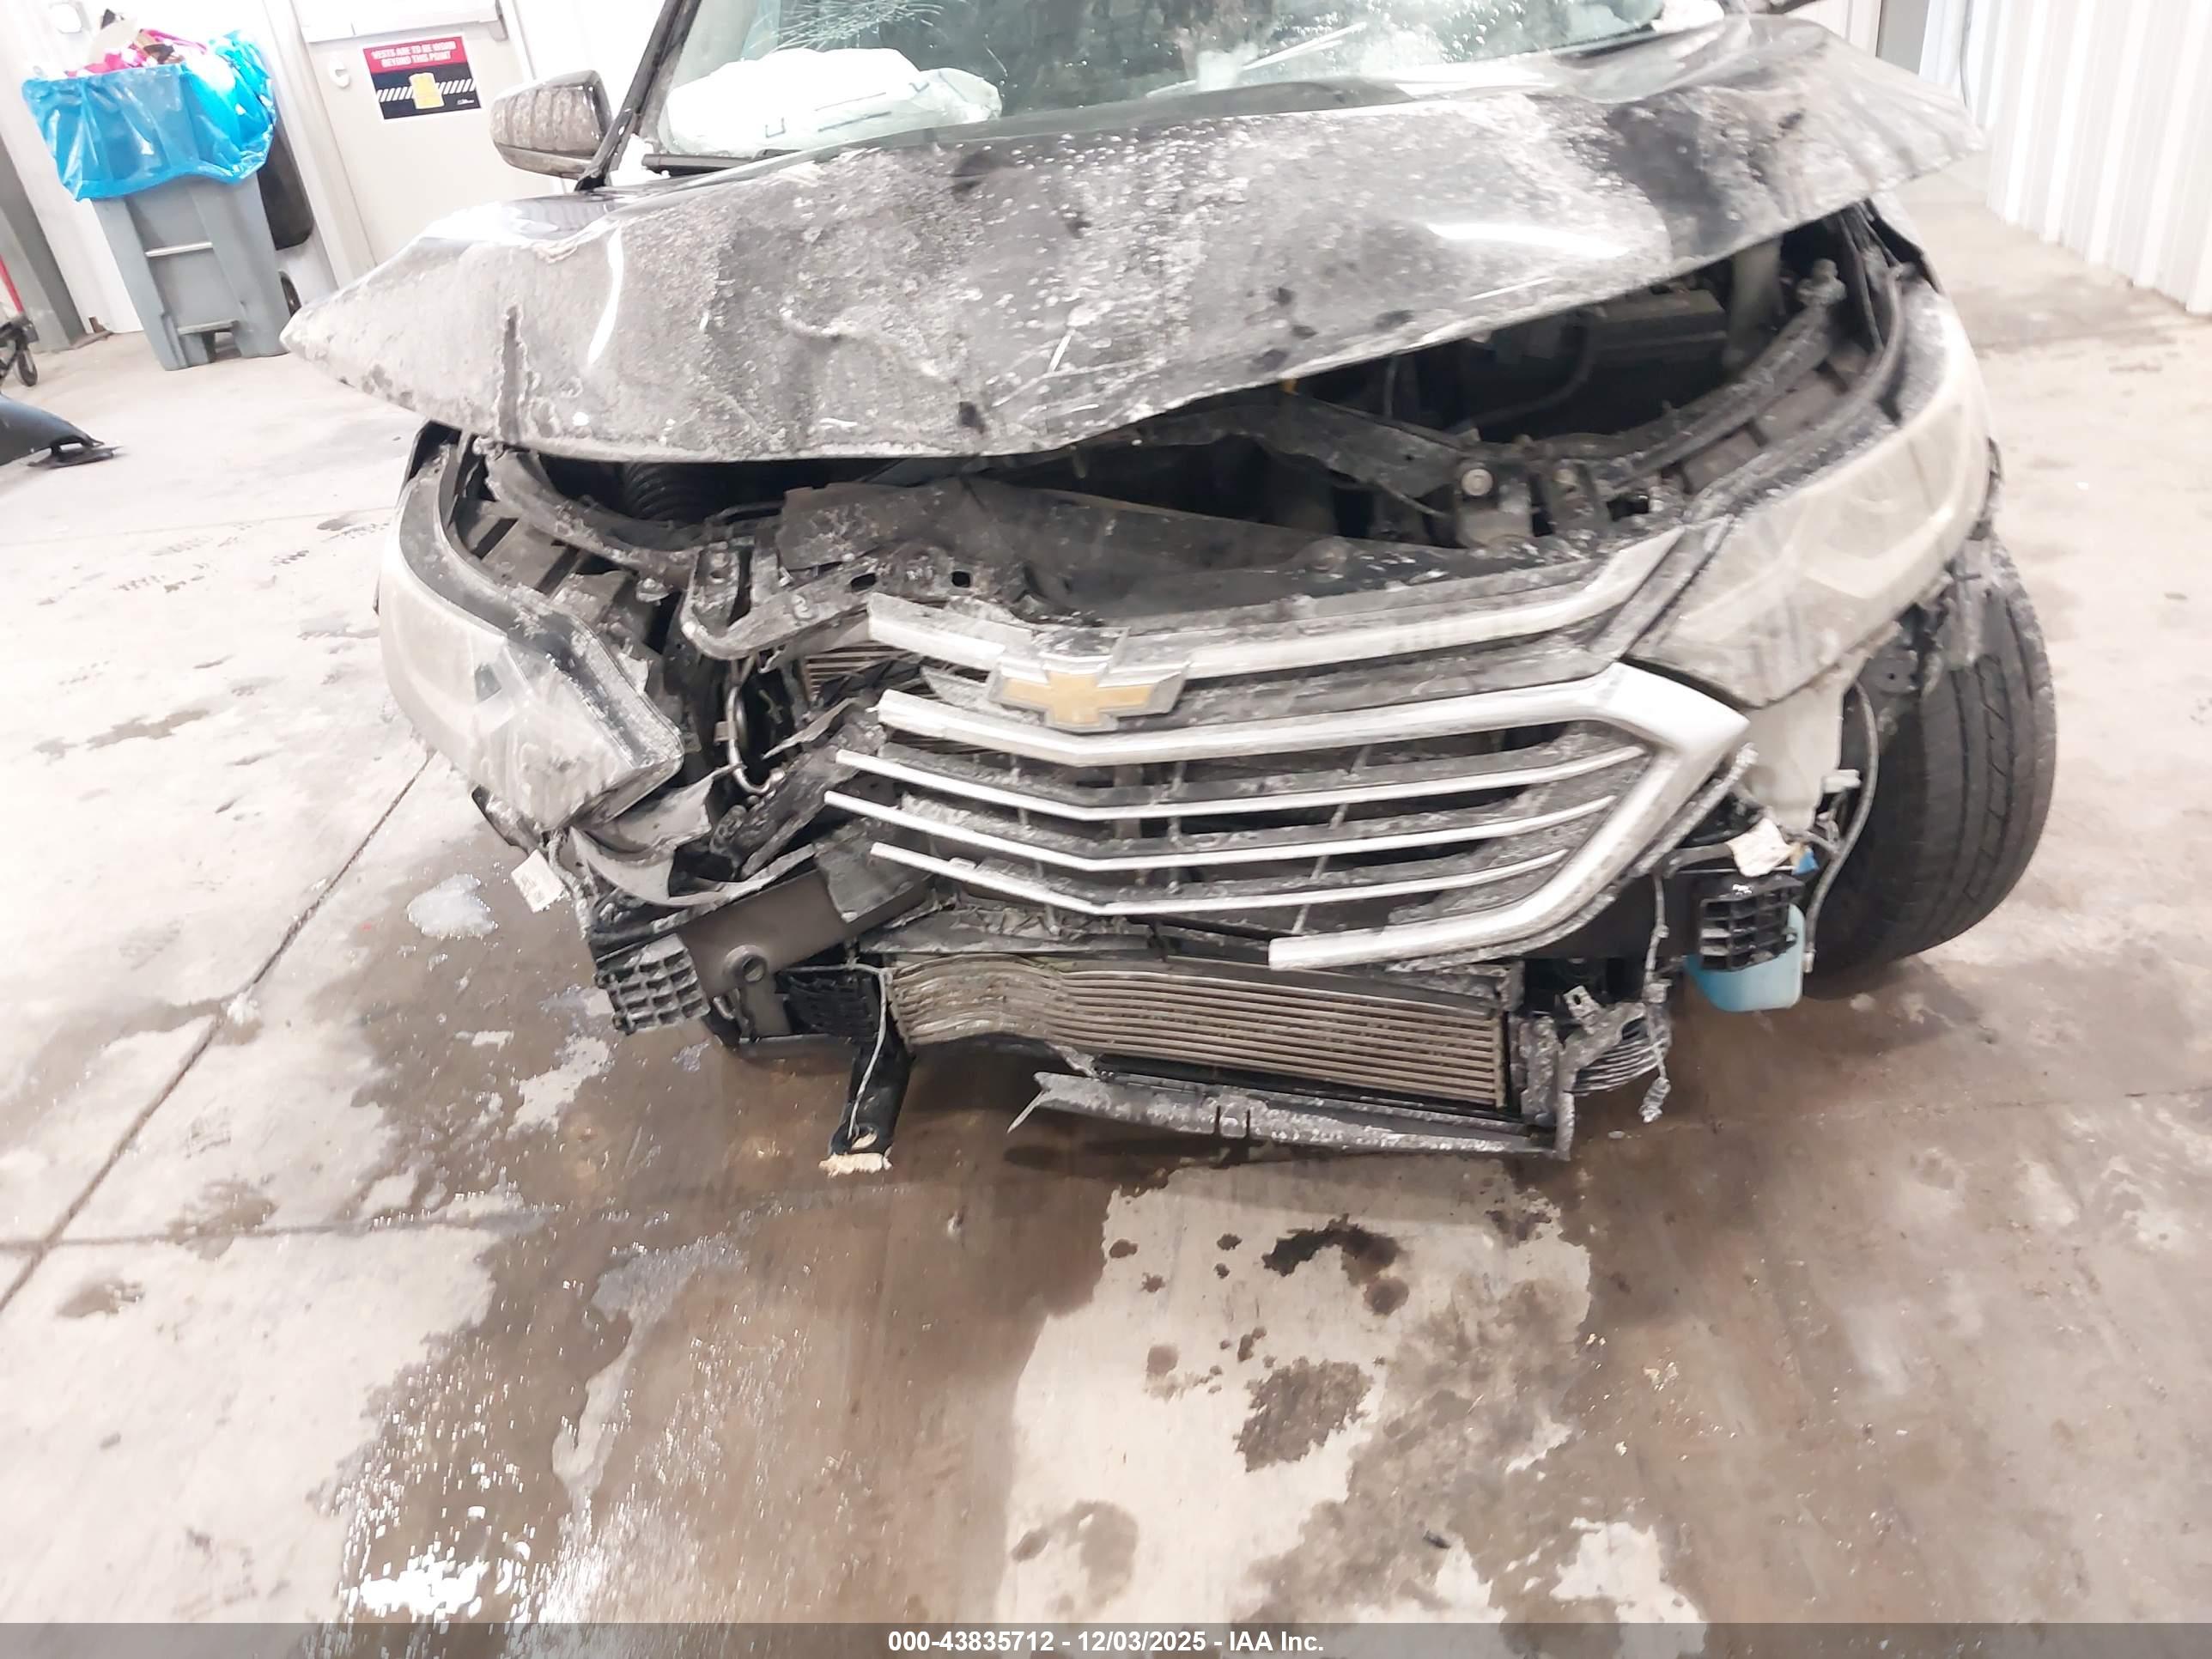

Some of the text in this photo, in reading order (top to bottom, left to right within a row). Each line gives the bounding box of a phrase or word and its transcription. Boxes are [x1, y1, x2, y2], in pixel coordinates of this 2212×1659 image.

[371, 49, 396, 59] VESTS
[396, 47, 410, 56] ARE
[410, 46, 422, 54] TO
[422, 44, 432, 53] BE
[380, 51, 451, 68] BEYOND THIS POINT
